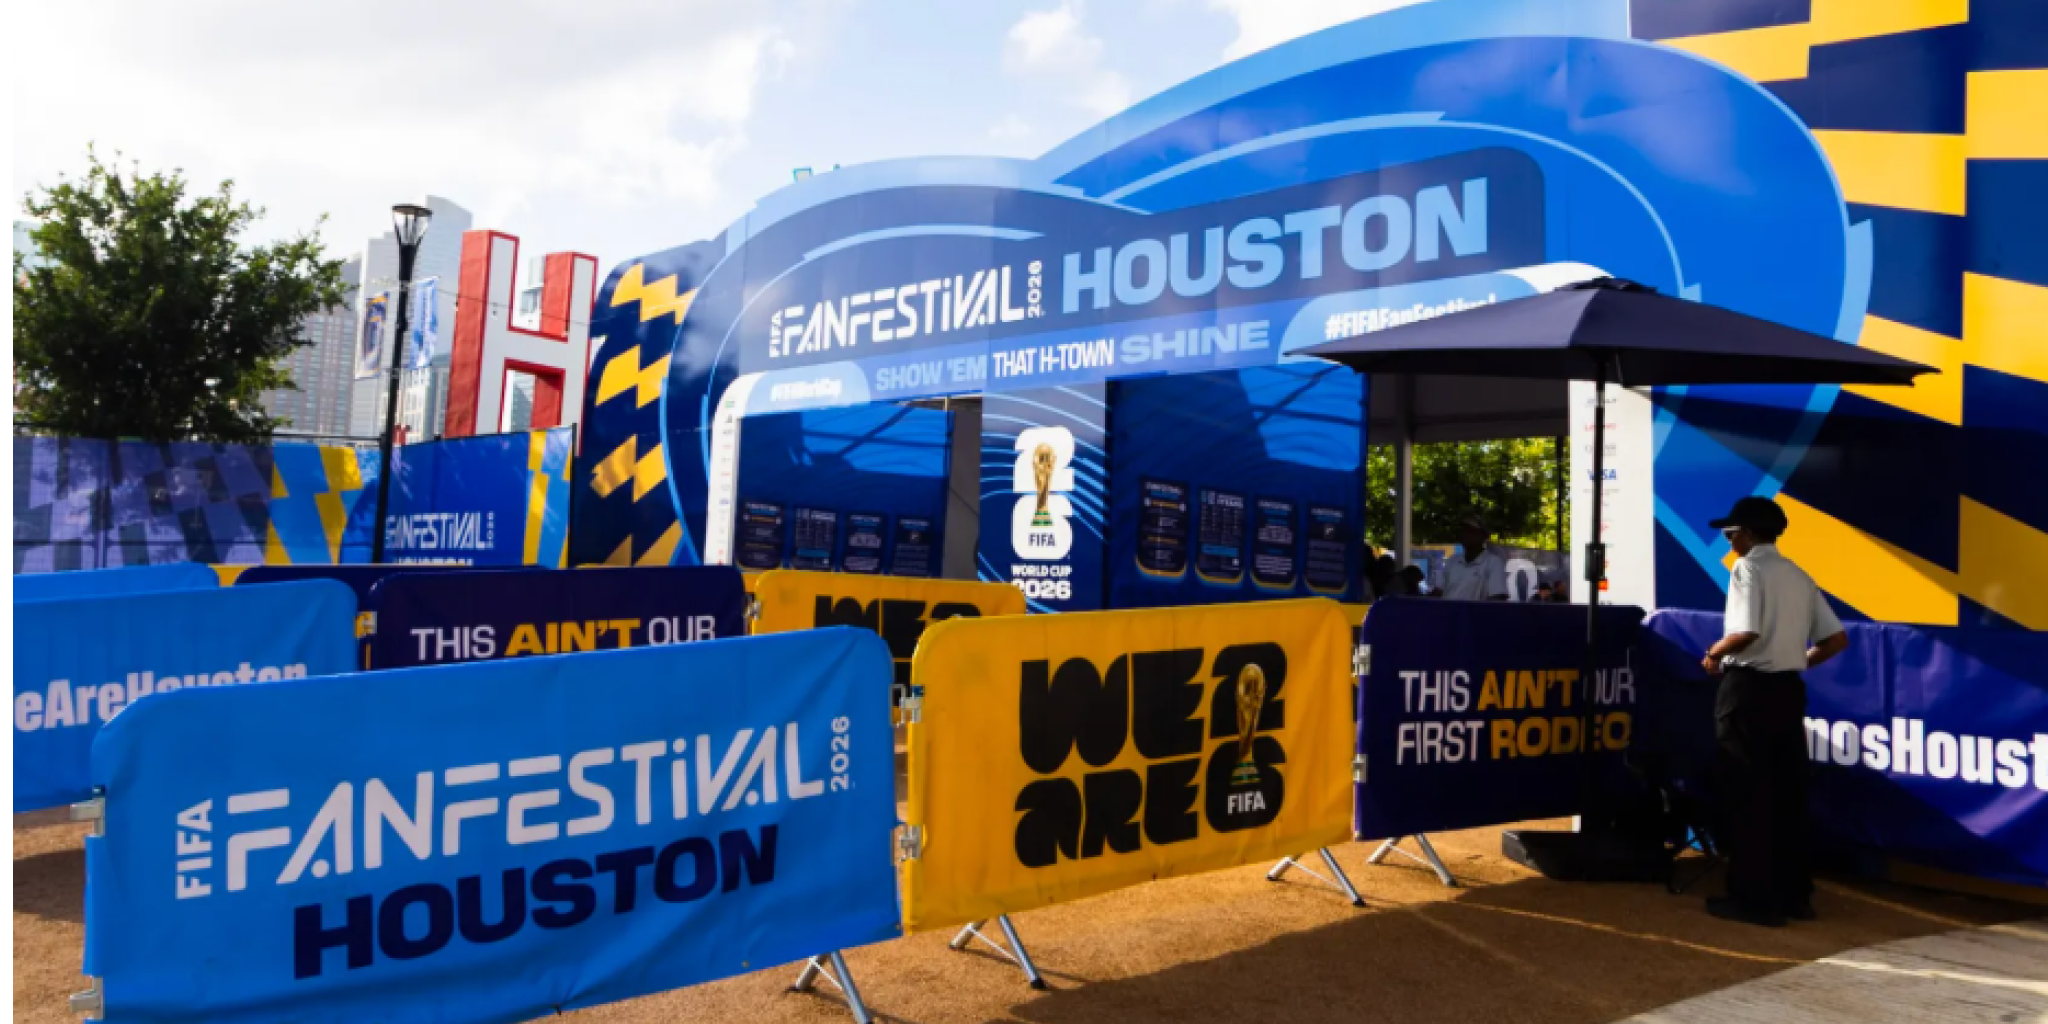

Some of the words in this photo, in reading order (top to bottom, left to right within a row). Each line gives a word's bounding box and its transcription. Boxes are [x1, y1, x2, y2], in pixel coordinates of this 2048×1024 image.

[1062, 177, 1488, 314] HOUSTON
[1028, 260, 1043, 319] 2026
[769, 310, 783, 358] FIFA
[876, 361, 943, 391] SHOW
[993, 350, 1038, 378] THAT
[1040, 339, 1115, 373] H-TOWN
[1120, 320, 1270, 364] SHINE
[1587, 468, 1617, 480] VSA
[1028, 532, 1056, 547] FIFA
[1011, 564, 1048, 577] WORLD
[1050, 564, 1072, 578] CUP
[411, 626, 496, 661] THIS
[504, 618, 641, 656] AIN'T
[648, 615, 716, 647] OUR
[1398, 670, 1471, 713] THIS
[1477, 668, 1580, 711] AIN'T
[830, 714, 852, 793] 2026
[1396, 720, 1485, 766] FIRST
[1227, 791, 1266, 816] FIFA
[174, 798, 213, 900] FIFA
[293, 823, 780, 980] HOUSTON
